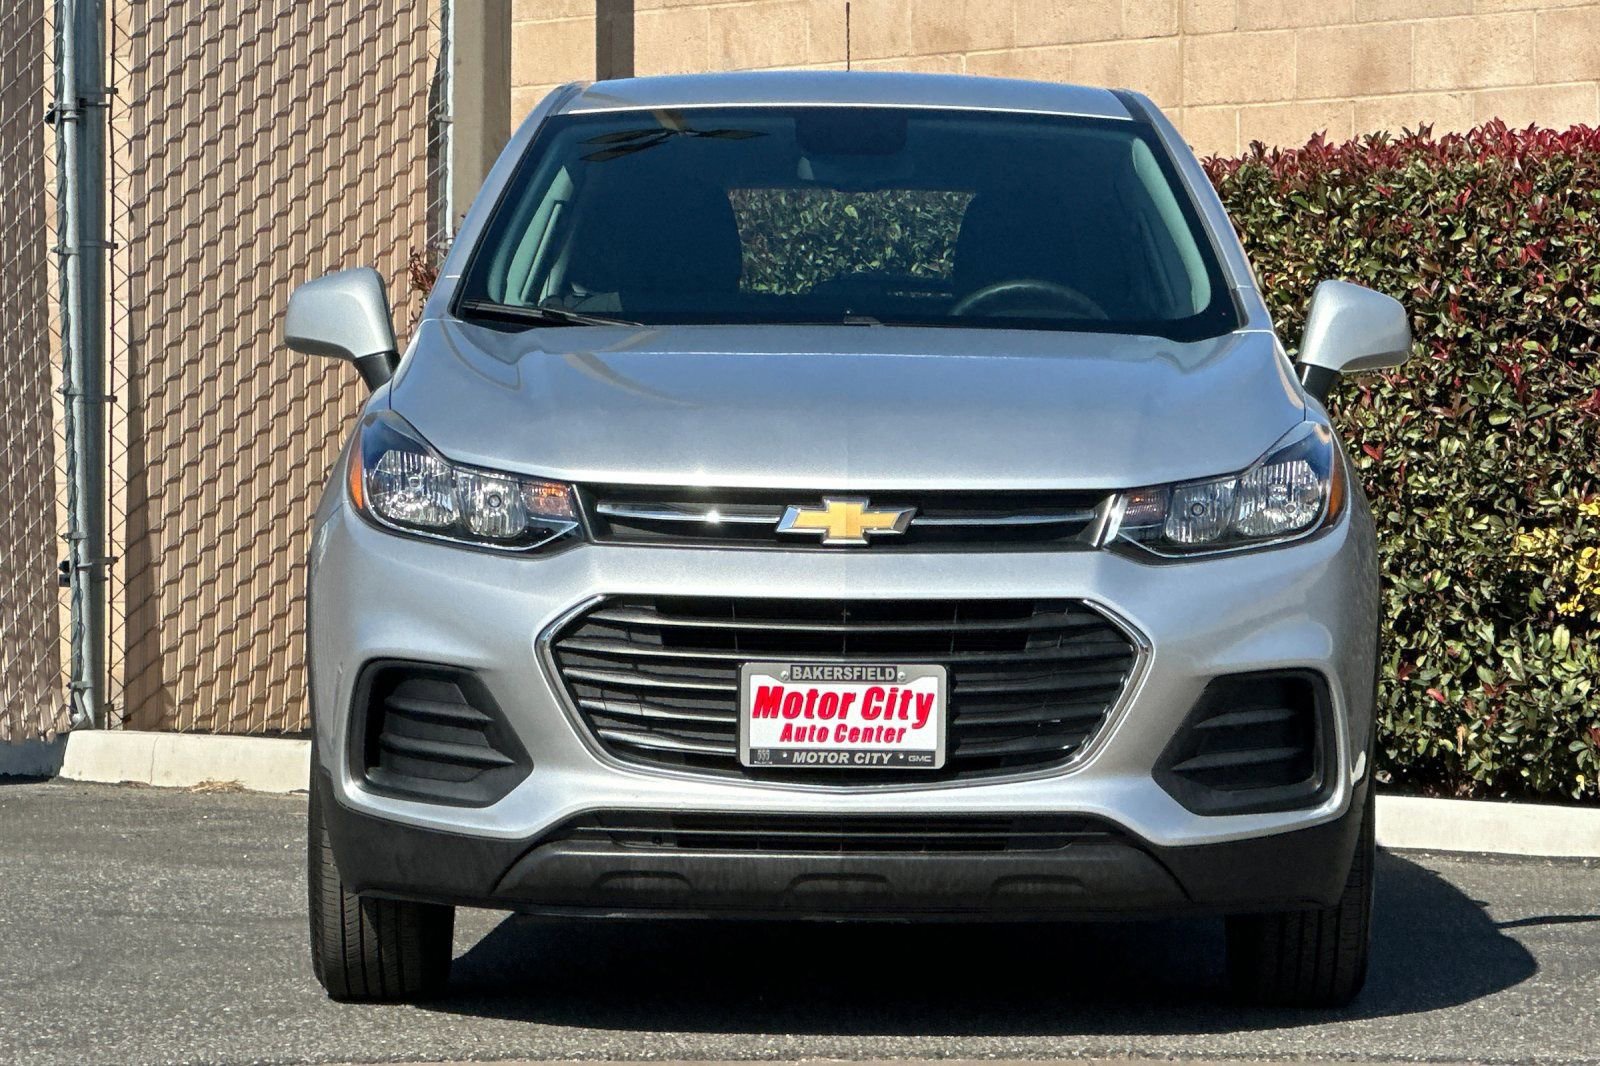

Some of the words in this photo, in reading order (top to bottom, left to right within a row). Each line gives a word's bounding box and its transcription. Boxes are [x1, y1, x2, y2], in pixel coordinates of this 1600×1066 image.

[792, 666, 896, 681] BAKERSFIELD
[752, 685, 857, 720] Motor
[861, 686, 935, 730] City
[779, 722, 830, 743] Auto
[833, 723, 908, 744] Center
[792, 752, 850, 764] MOTOR
[854, 752, 893, 765] CITY
[908, 755, 932, 763] GMC
